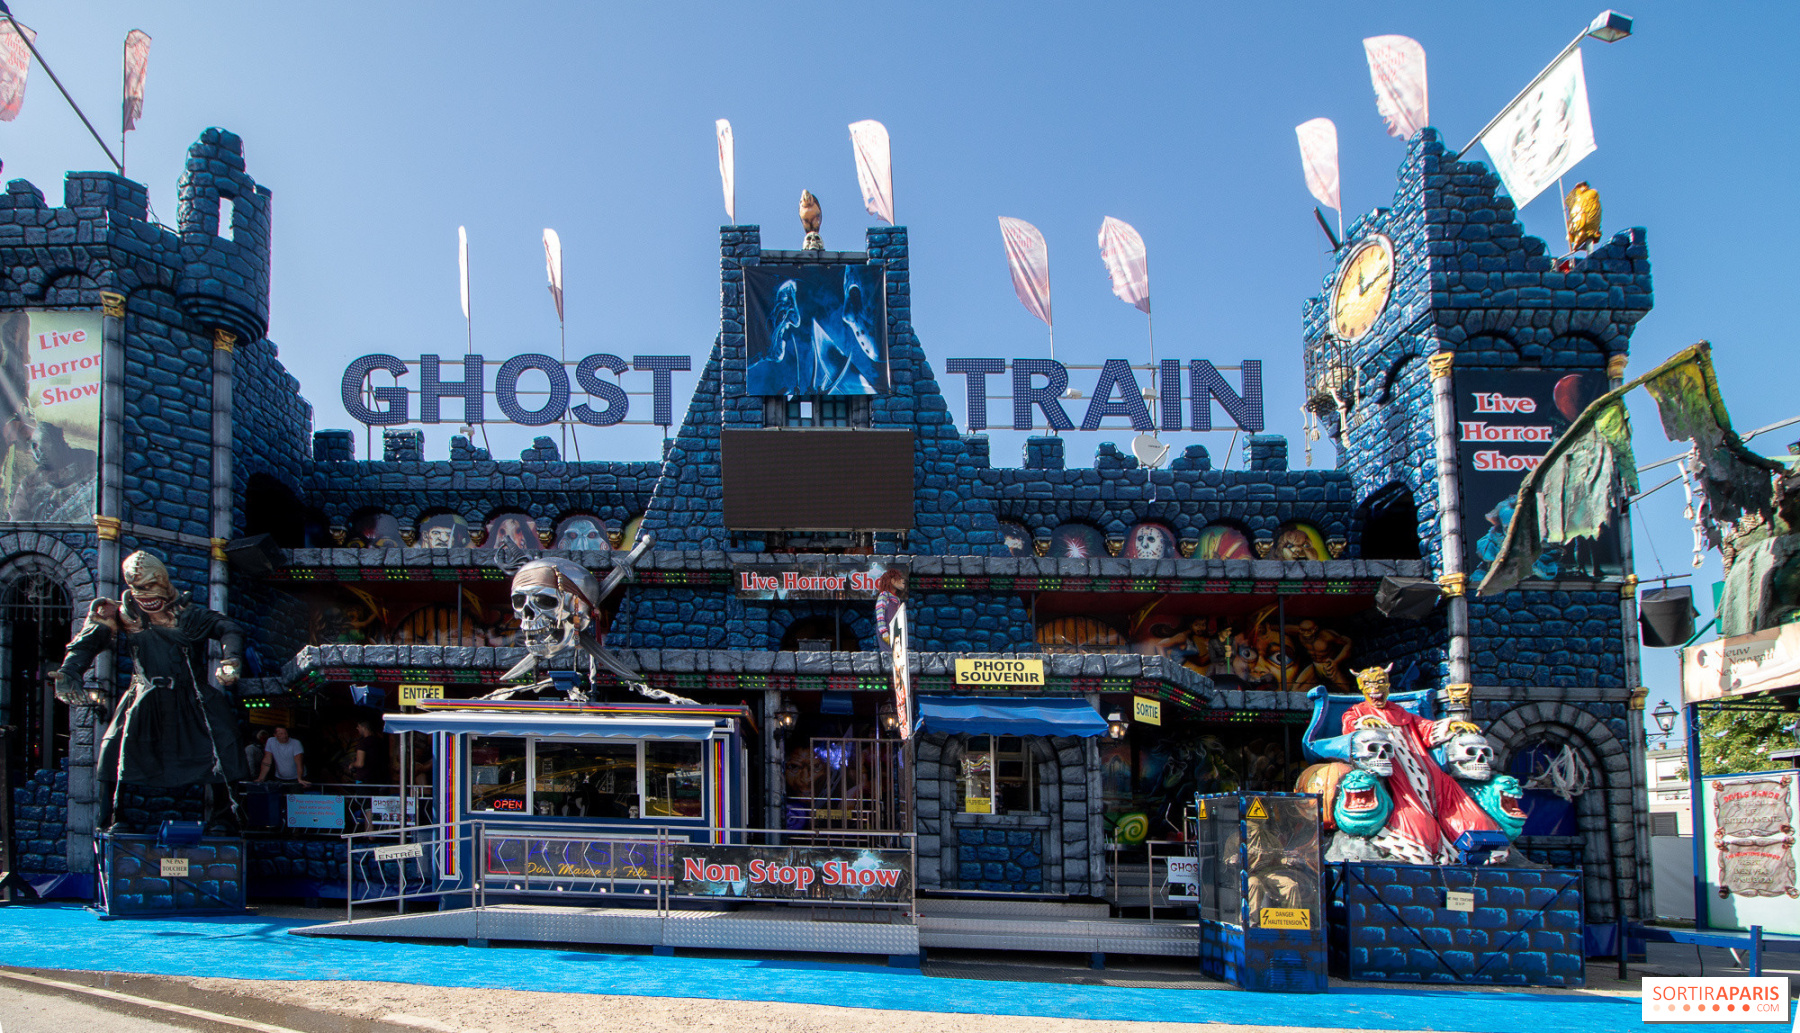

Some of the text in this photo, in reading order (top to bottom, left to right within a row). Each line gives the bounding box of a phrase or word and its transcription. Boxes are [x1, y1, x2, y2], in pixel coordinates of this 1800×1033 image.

[39, 330, 86, 350] Live
[30, 354, 101, 380] Horror
[42, 383, 99, 406] Show
[341, 353, 1264, 432] GHOST TRAIN
[1473, 393, 1537, 413] Live
[1459, 422, 1552, 442] Horror
[740, 572, 778, 590] Live
[783, 572, 846, 590] Horror
[974, 661, 1025, 671] PHOTO
[961, 672, 1039, 682] SOUVENIR
[1136, 702, 1158, 719] SORTIE
[494, 799, 523, 809] OPEN
[379, 850, 421, 860] ENTRÉE
[495, 839, 674, 867] CAISSE
[526, 862, 550, 874] Dir.
[623, 866, 648, 877] Fils
[683, 858, 900, 891] Non Stop Show
[1170, 862, 1199, 873] GHOS
